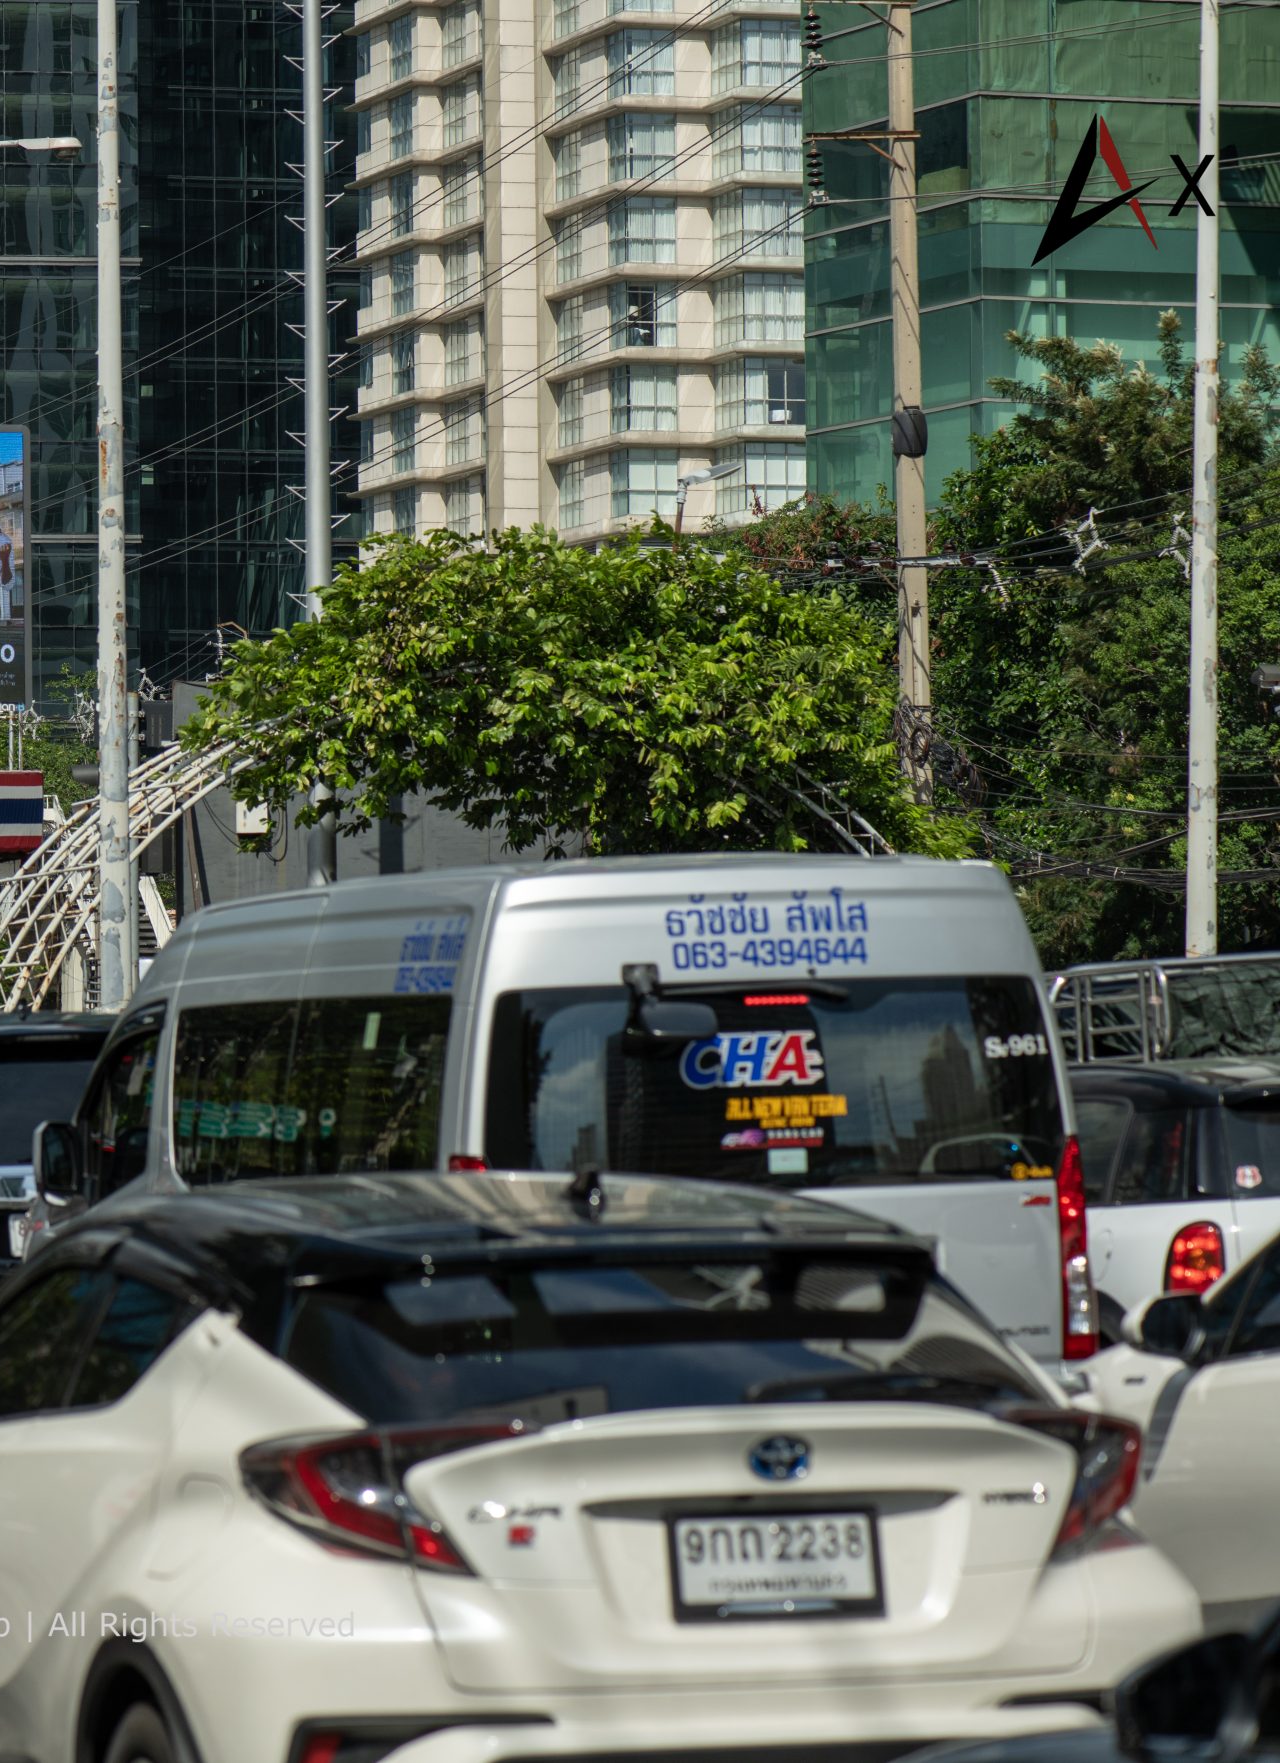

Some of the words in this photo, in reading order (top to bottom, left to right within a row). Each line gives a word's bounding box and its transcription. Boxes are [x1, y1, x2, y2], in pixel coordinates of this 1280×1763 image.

[665, 893, 770, 937] ธวัชชัย
[785, 886, 869, 933] สัพโส
[672, 937, 868, 970] 063-4394644
